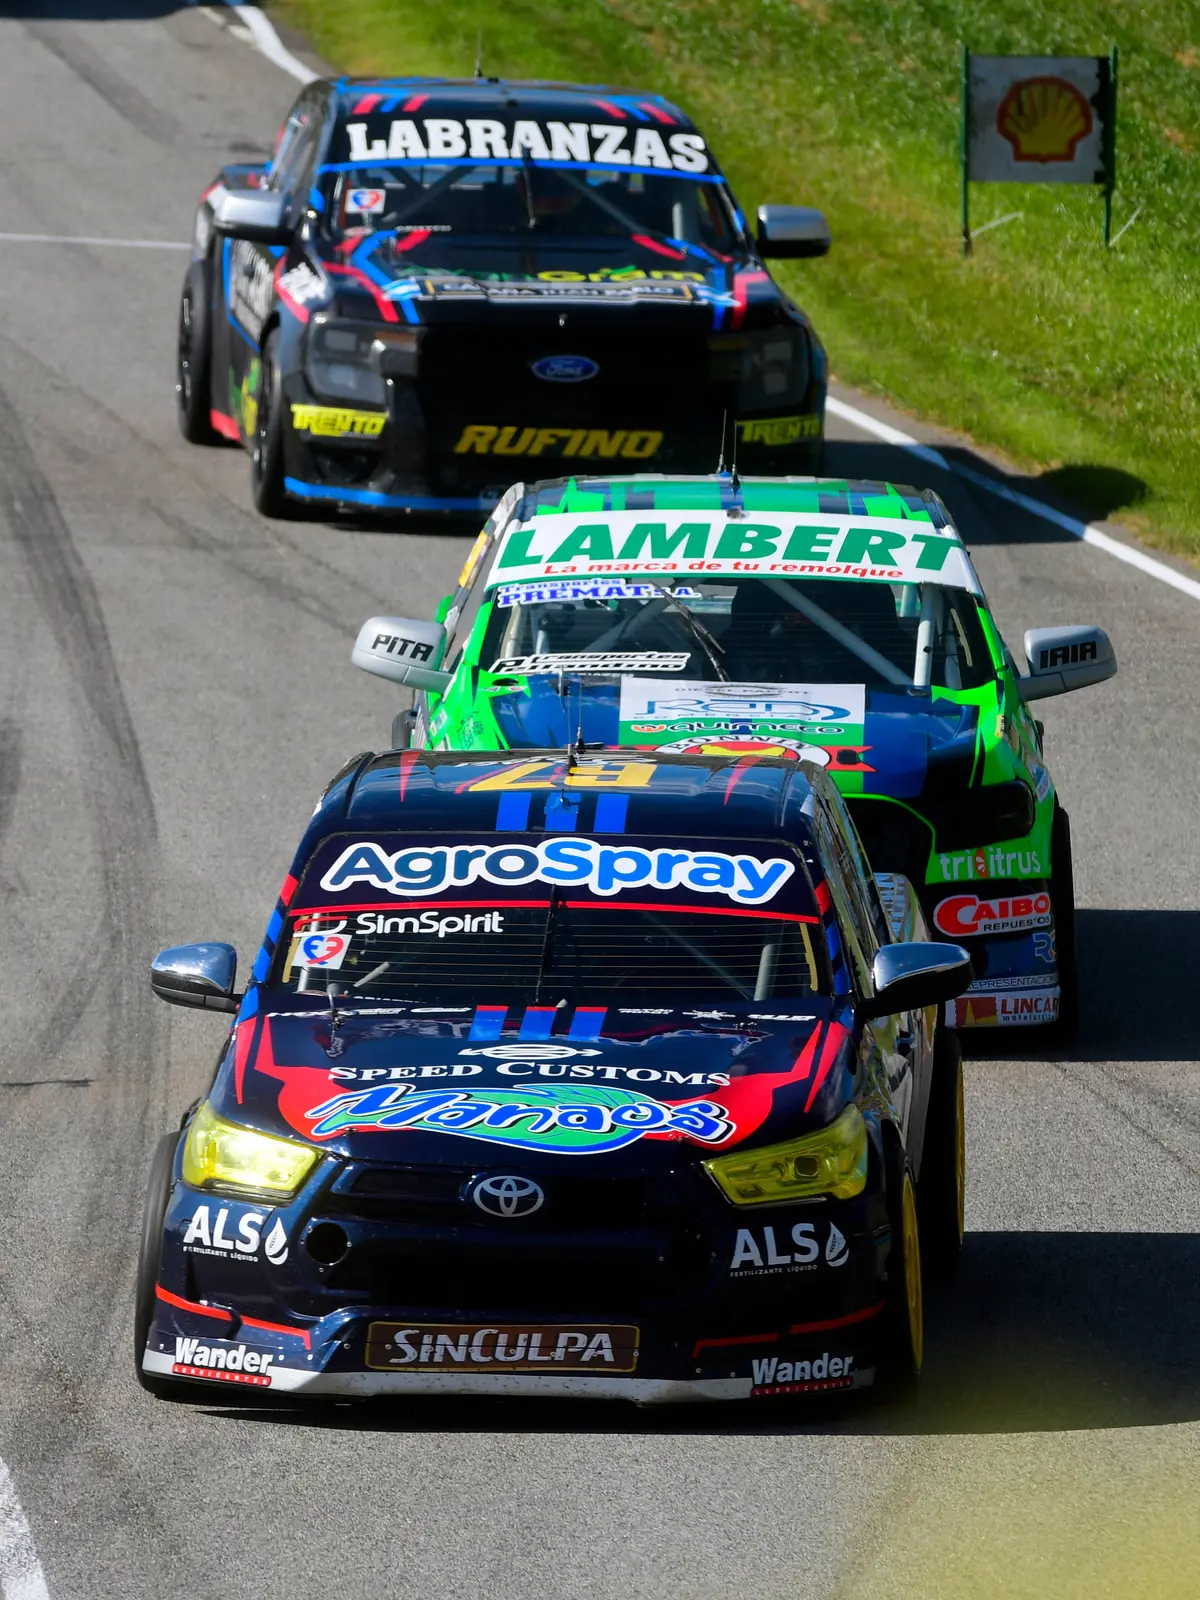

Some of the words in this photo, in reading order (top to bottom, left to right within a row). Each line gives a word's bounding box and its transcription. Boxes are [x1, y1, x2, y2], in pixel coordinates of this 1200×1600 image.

[346, 119, 709, 173] LABRANZAS
[290, 404, 387, 436] TRENTO
[738, 415, 822, 445] TRENTO
[454, 425, 664, 459] RUFINO
[498, 523, 963, 572] LAMBERT
[500, 578, 622, 593] Transportes
[543, 565, 577, 575] La
[588, 561, 677, 573] marca
[688, 560, 723, 571] de
[732, 560, 759, 571] tu
[769, 562, 904, 578] remolque
[372, 633, 435, 662] PITA
[326, 838, 792, 904] AgroSpray
[356, 911, 504, 938] SimSpirit
[936, 893, 1050, 935] CAIBO
[982, 916, 1051, 932] REPUESTOS
[327, 1064, 483, 1082] SPEED
[495, 1061, 731, 1087] CUSTOMS
[304, 1083, 738, 1145] Manaos
[183, 1205, 264, 1253] ALS
[730, 1222, 819, 1269] ALS
[730, 1267, 783, 1278] FERTILIZANTE
[175, 1336, 273, 1374] Wander
[751, 1352, 854, 1385] Wander
